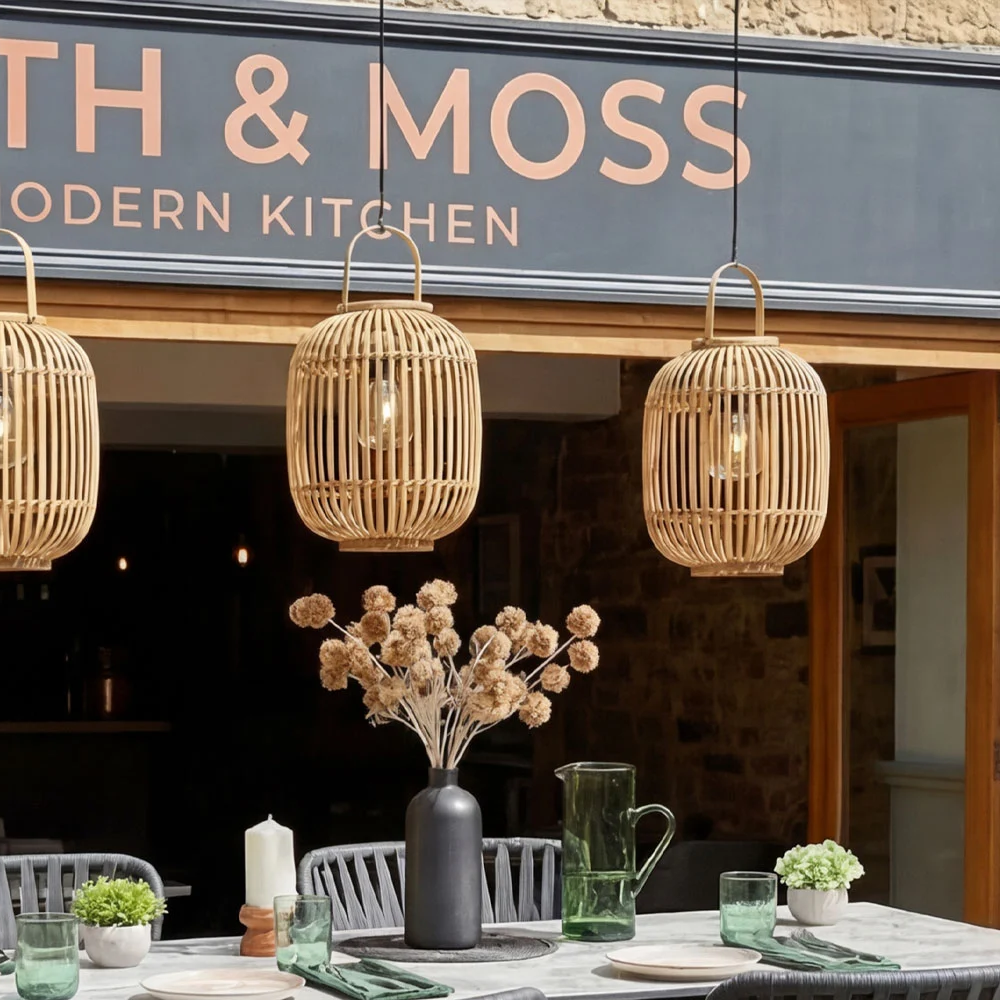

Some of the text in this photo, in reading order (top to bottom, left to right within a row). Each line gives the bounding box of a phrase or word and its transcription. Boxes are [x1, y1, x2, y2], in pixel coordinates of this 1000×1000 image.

[224, 54, 311, 166] &
[369, 62, 752, 190] MOSS
[262, 194, 518, 247] KITCHEN
